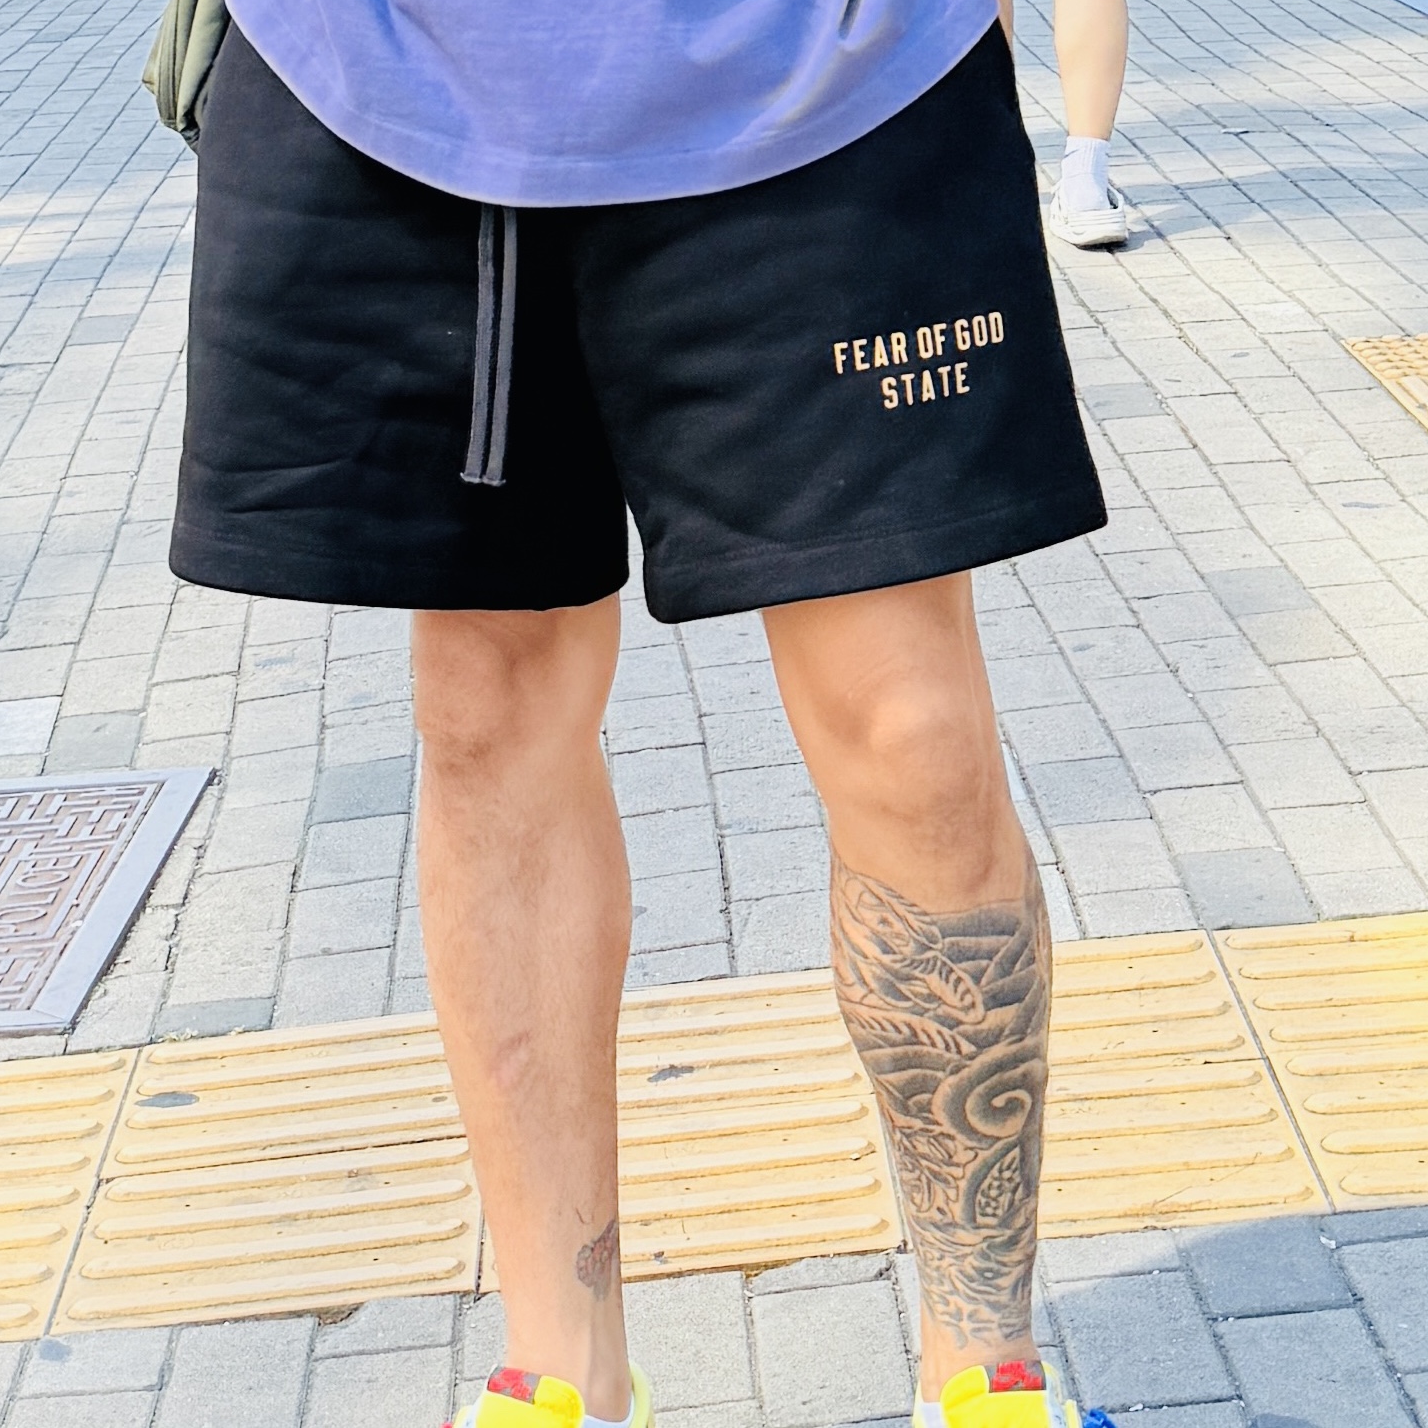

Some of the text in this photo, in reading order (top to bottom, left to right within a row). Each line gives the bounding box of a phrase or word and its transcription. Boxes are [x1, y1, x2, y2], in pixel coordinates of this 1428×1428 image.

[833, 310, 1005, 376] FEAR OF GOD
[880, 361, 971, 410] STATE
